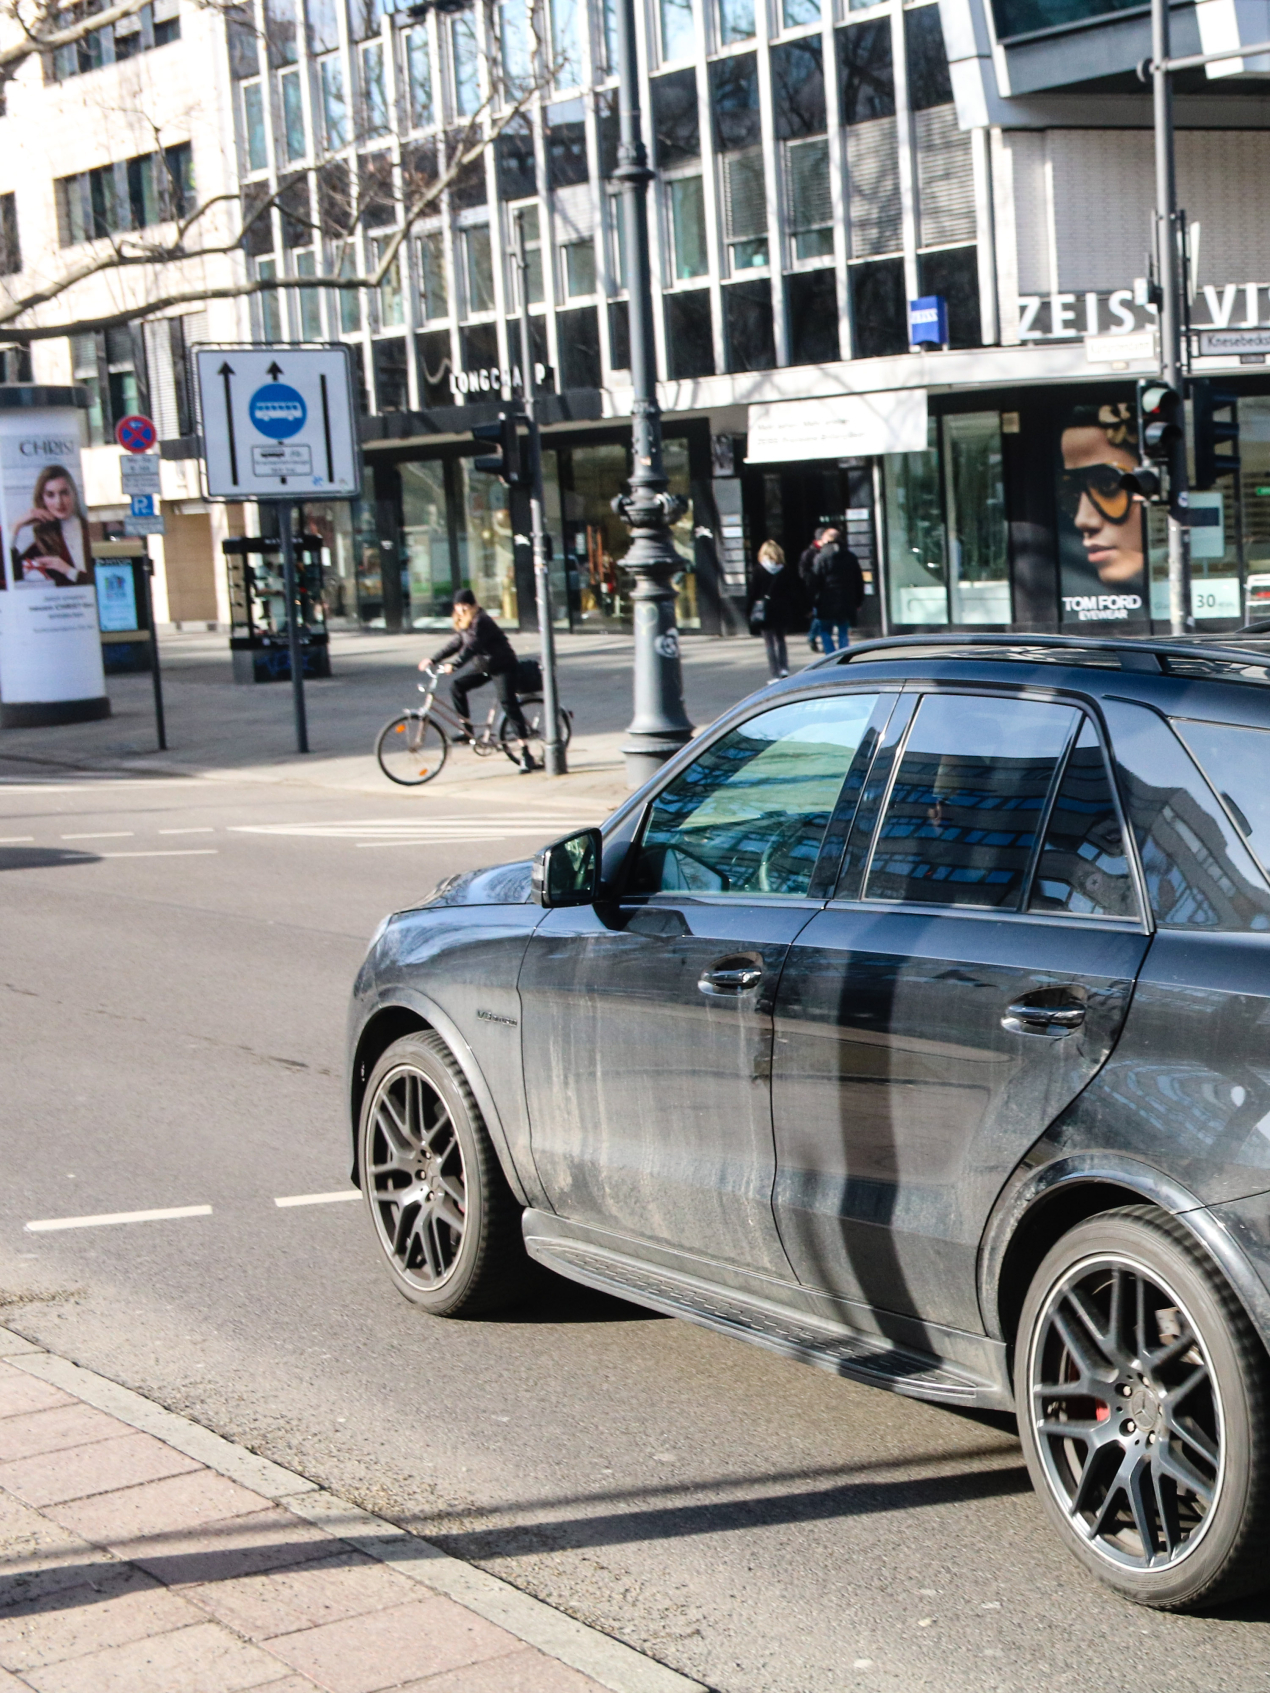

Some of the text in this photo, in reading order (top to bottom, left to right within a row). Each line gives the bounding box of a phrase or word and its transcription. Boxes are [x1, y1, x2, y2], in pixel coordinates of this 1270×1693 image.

[449, 362, 546, 394] LONGCHAP
[1062, 597, 1097, 611] TOM
[1099, 594, 1142, 610] FORD
[1196, 594, 1217, 608] 30
[1078, 609, 1129, 621] EYEWEAR
